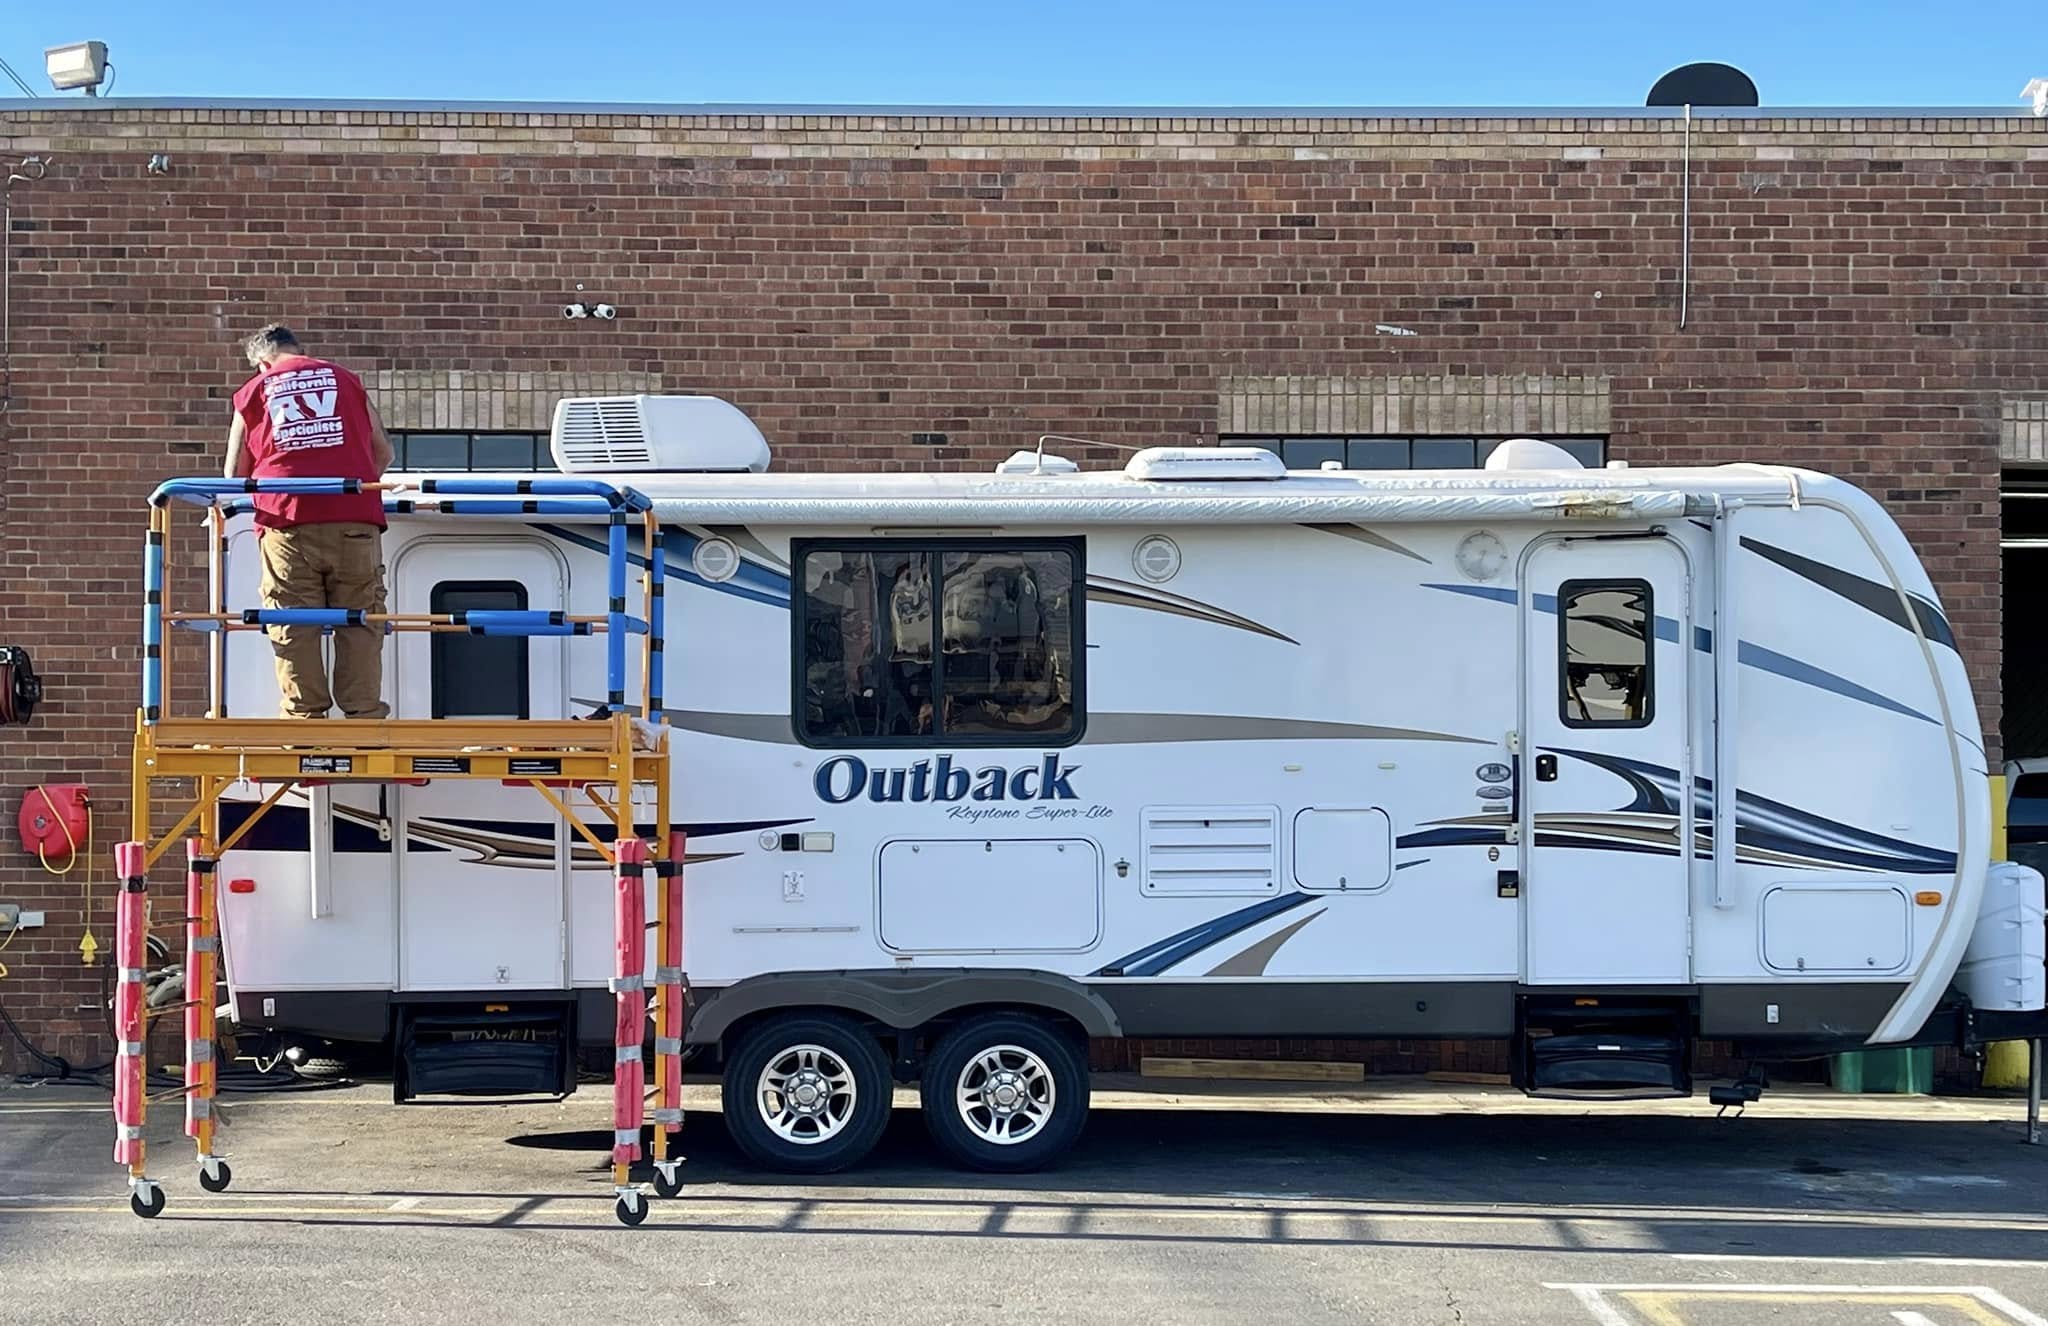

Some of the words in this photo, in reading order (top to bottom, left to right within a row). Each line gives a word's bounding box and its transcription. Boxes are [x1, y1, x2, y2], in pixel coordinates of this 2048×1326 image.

[269, 391, 337, 425] RV
[813, 752, 1082, 804] Outback
[945, 805, 1020, 825] Keystone
[1025, 805, 1113, 821] Super-Lite
